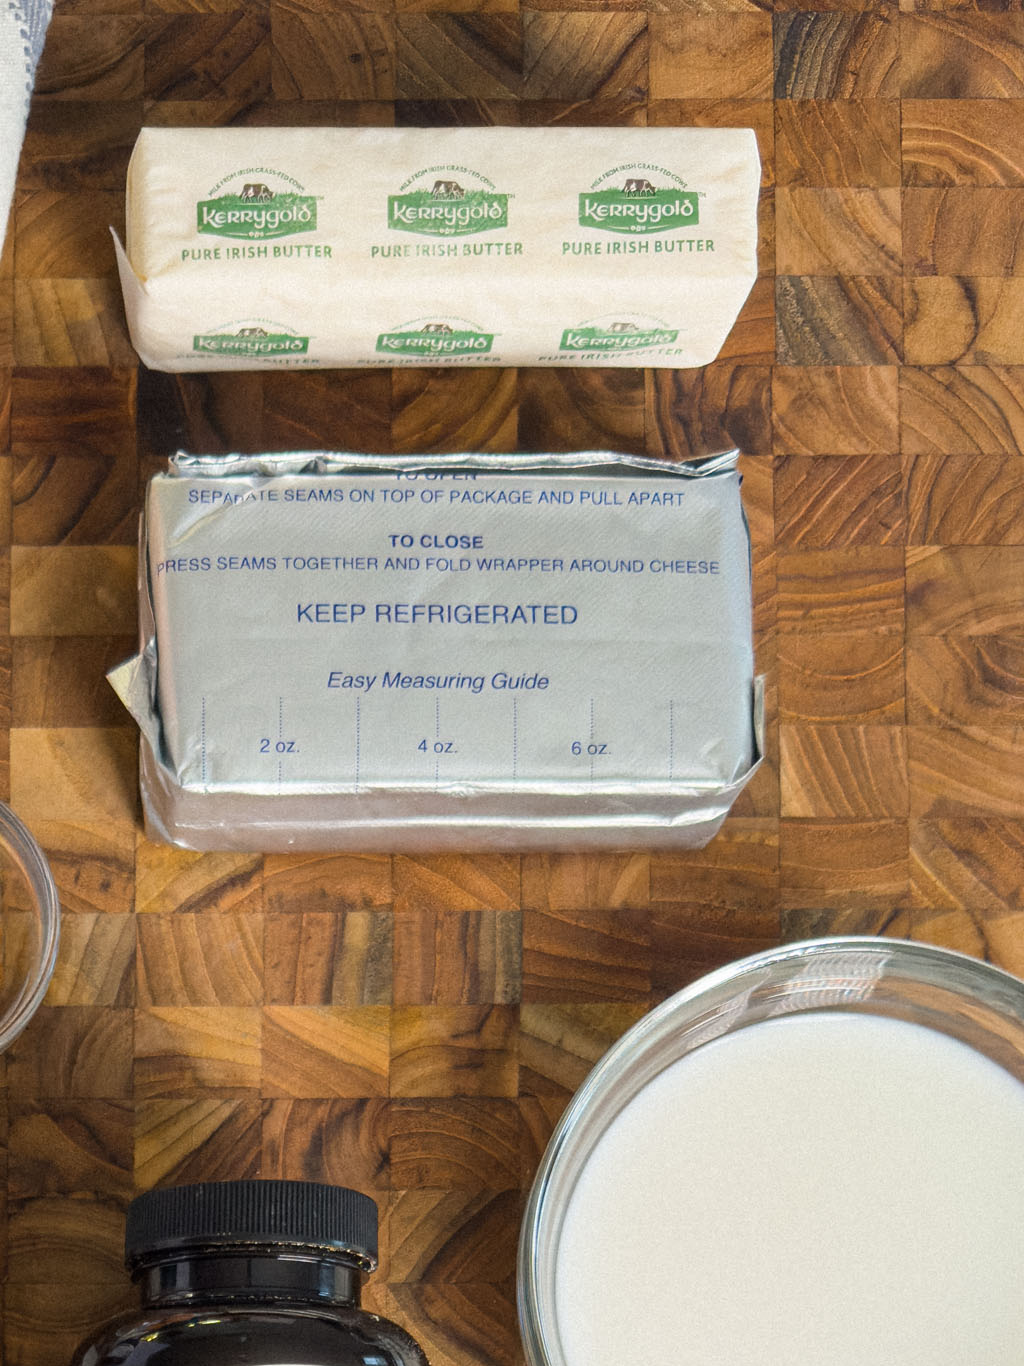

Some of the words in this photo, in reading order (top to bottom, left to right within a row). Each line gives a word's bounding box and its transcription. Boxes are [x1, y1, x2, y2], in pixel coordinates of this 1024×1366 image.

[182, 248, 222, 261] PURE
[226, 246, 268, 260] IRISH
[273, 245, 333, 258] BUTTER
[371, 245, 411, 258] PURE
[416, 244, 458, 257] IRISH
[463, 242, 524, 256] BUTTER
[562, 241, 602, 255] PURE
[607, 241, 649, 254] IRISH
[654, 239, 716, 252] BUTTER
[284, 489, 345, 503] SEAMS
[349, 489, 375, 503] ON
[380, 489, 415, 503] TOP
[420, 489, 444, 503] OF
[450, 490, 533, 505] PACKAGE
[538, 491, 574, 505] AND
[579, 491, 623, 506] PULL
[628, 492, 685, 507] APART
[388, 534, 414, 549] TO
[420, 535, 484, 549] CLOSE
[157, 557, 211, 577] PRESS
[216, 557, 277, 571] SEAMS
[282, 557, 378, 571] TOGETHER
[384, 557, 420, 571] AND
[426, 558, 471, 572] FOLD
[476, 558, 564, 573] WRAPPER
[569, 559, 645, 574] AROUND
[649, 560, 721, 575] CHEESE
[296, 602, 366, 624] KEEP
[375, 603, 578, 626] REFRIGERATED
[327, 671, 377, 694] Easy
[382, 671, 485, 694] Measuring
[490, 671, 550, 691] Guide
[259, 738, 270, 755] 2
[275, 742, 301, 755] oz.
[416, 738, 428, 755] 4
[433, 742, 459, 755] oz.
[570, 740, 582, 757] 6
[587, 743, 613, 757] oz.
